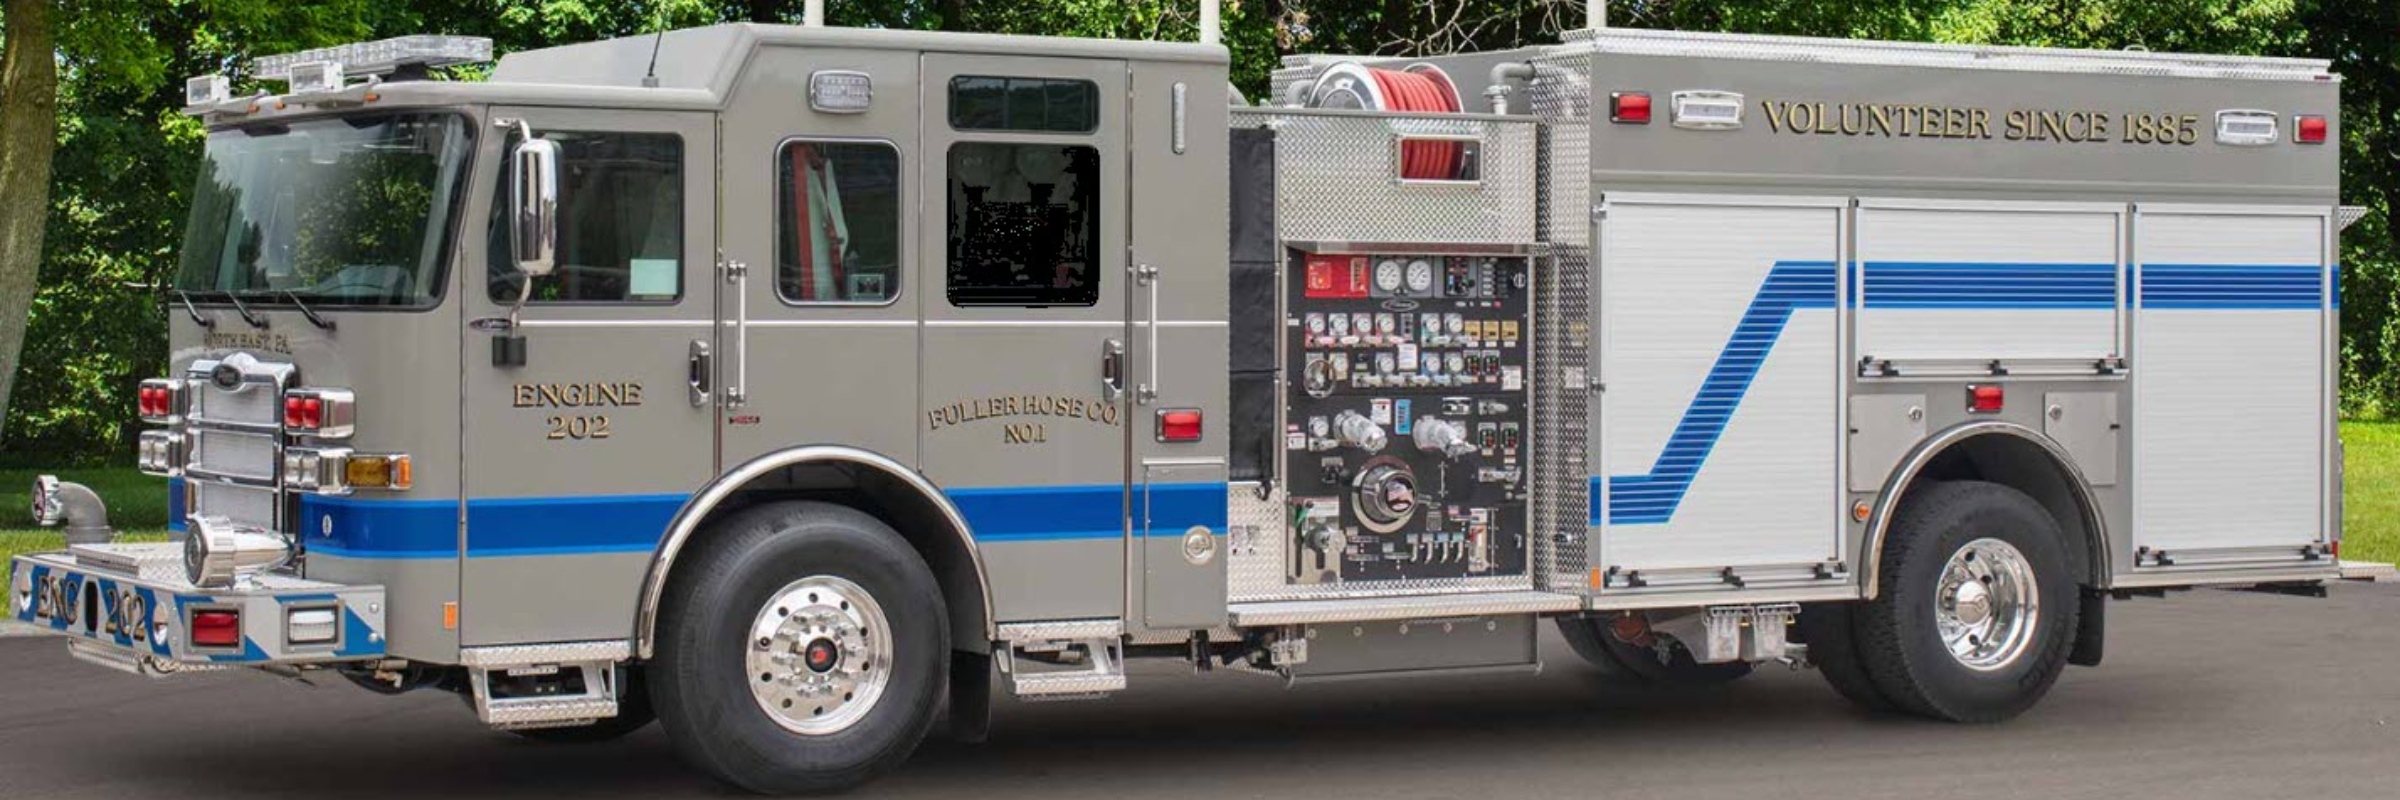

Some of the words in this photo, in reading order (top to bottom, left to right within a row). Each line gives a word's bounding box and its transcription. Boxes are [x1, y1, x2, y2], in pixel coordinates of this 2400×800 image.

[1762, 101, 1992, 139] VOLUNTEER
[2004, 109, 2109, 143] SINCE
[2122, 113, 2199, 145] 1885
[513, 382, 643, 408] ENGINE
[928, 396, 1020, 430] FULLER
[1022, 395, 1083, 418] HOSE
[1086, 402, 1120, 427] CO.
[546, 415, 611, 440] 202
[36, 575, 80, 625] ENG
[105, 587, 146, 643] 202
